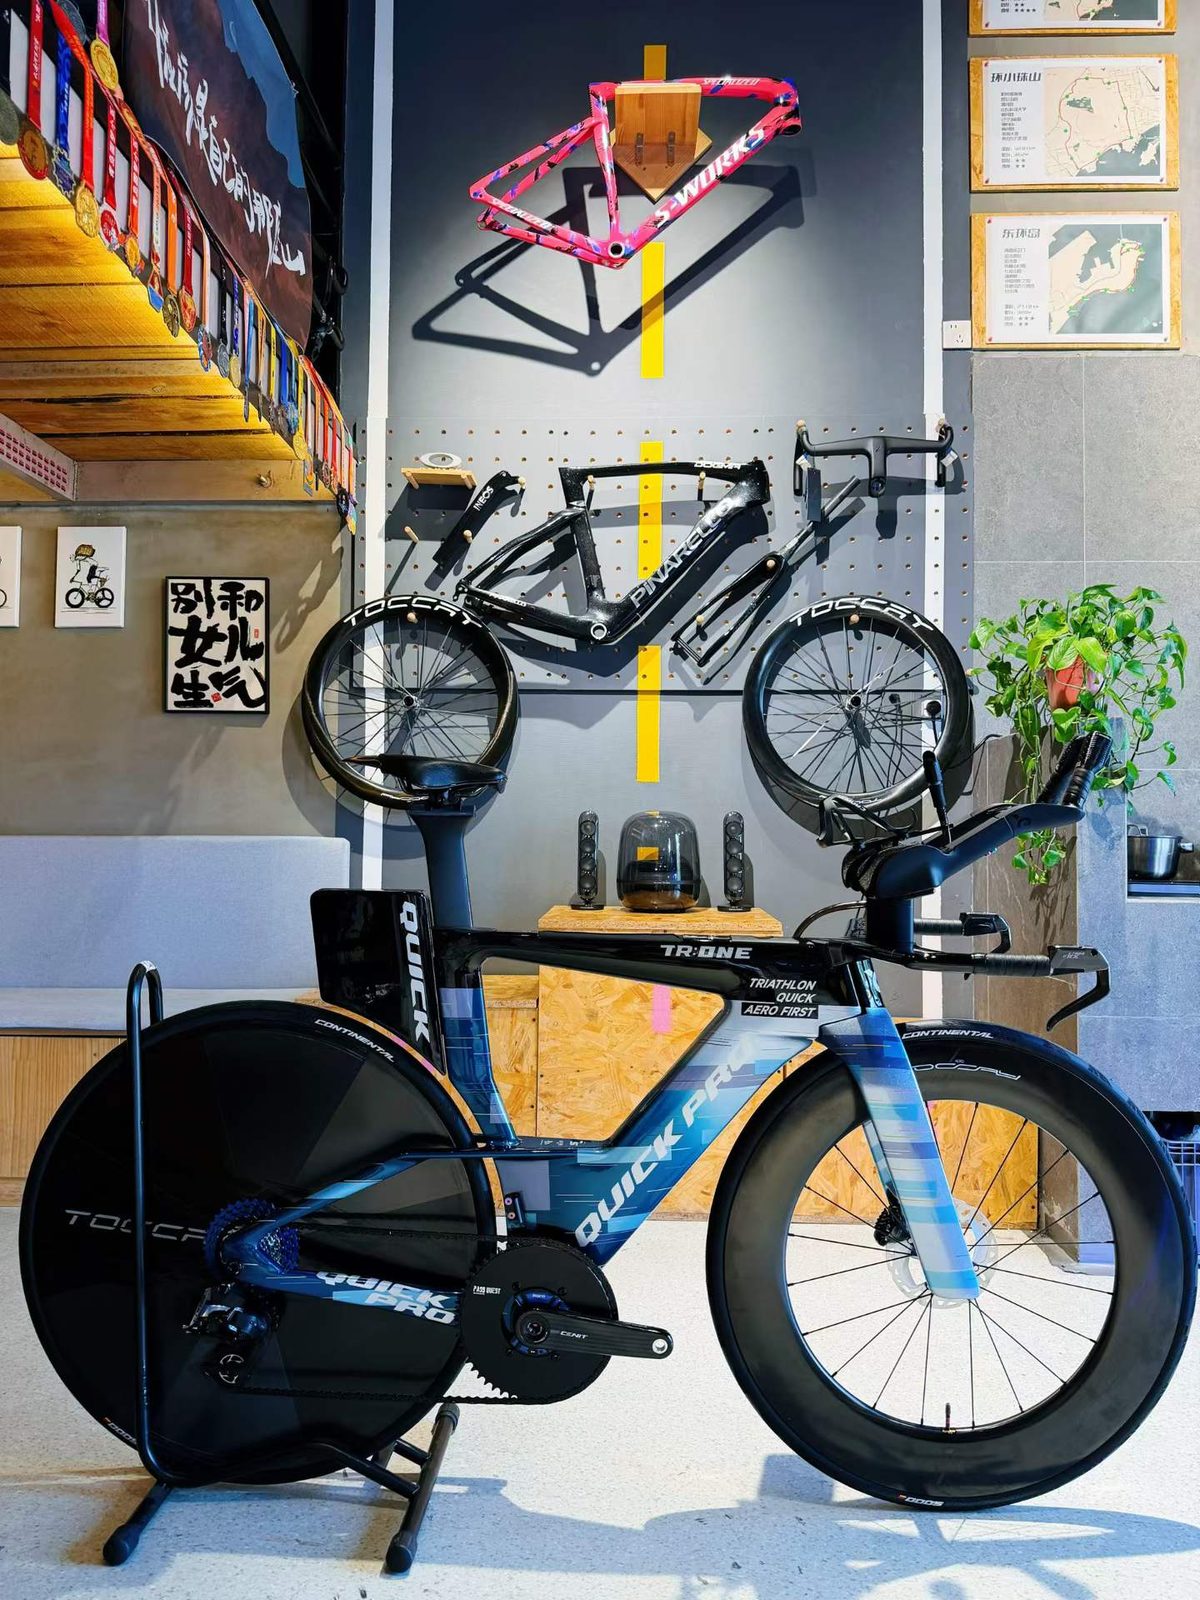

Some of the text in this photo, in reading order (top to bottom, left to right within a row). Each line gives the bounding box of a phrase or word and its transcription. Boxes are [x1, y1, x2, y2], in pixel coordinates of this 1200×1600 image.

[702, 77, 761, 87] SPECIALIZED
[990, 72, 1042, 83] 环小珠山
[654, 127, 766, 229] S-WORKS
[491, 197, 554, 231] SPECIALIZED
[1002, 229, 1041, 239] 东环岛
[473, 485, 495, 512] INEOS
[630, 496, 734, 610] PINARELLO
[399, 900, 431, 1044] QUICK
[749, 977, 817, 991] TRIATHLON
[743, 1004, 817, 1018] AERO FIRST
[775, 992, 817, 1004] QUICK
[314, 1018, 395, 1063] CONTINENTAL
[902, 1029, 995, 1040] CONTINENTAL
[575, 1118, 684, 1248] QUICK
[315, 1270, 452, 1309] QUICK
[364, 1291, 456, 1325] PRO
[560, 1329, 589, 1340] CENIT
